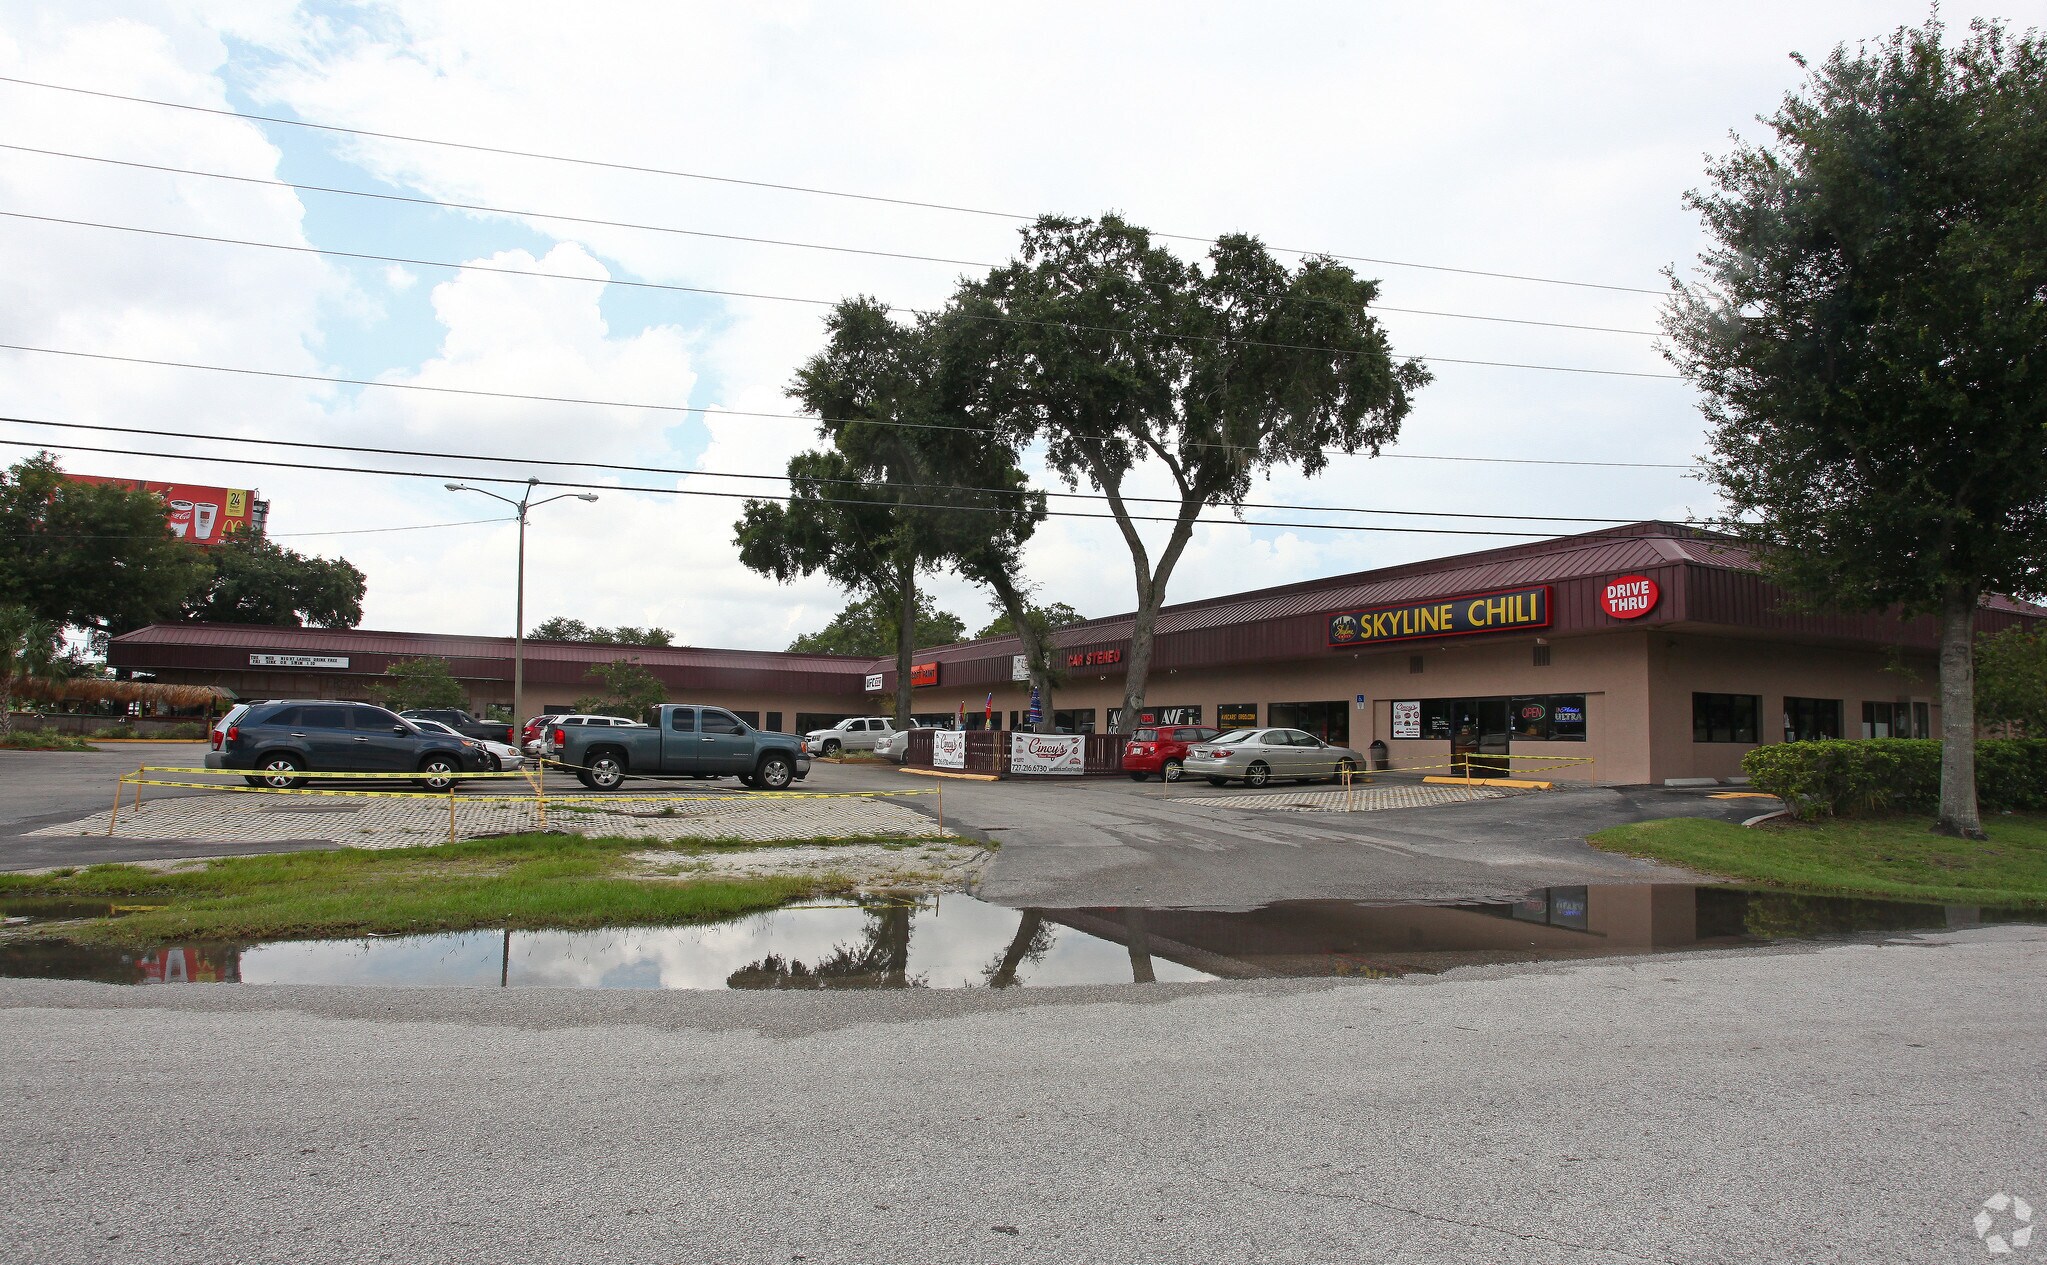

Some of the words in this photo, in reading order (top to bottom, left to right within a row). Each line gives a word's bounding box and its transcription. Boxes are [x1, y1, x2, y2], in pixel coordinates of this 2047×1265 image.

[230, 492, 241, 505] 24
[1607, 580, 1650, 599] DRIVE
[1609, 595, 1648, 613] THRU
[1360, 604, 1453, 639] SKYLINE
[1467, 593, 1537, 627] CHILI
[1067, 654, 1083, 667] CAR
[1086, 649, 1121, 666] STEREO
[1522, 707, 1542, 718] OPEN
[1554, 712, 1582, 721] ULTRA
[1028, 737, 1068, 762] Cincy's
[1012, 763, 1048, 773] 727.216.6730
